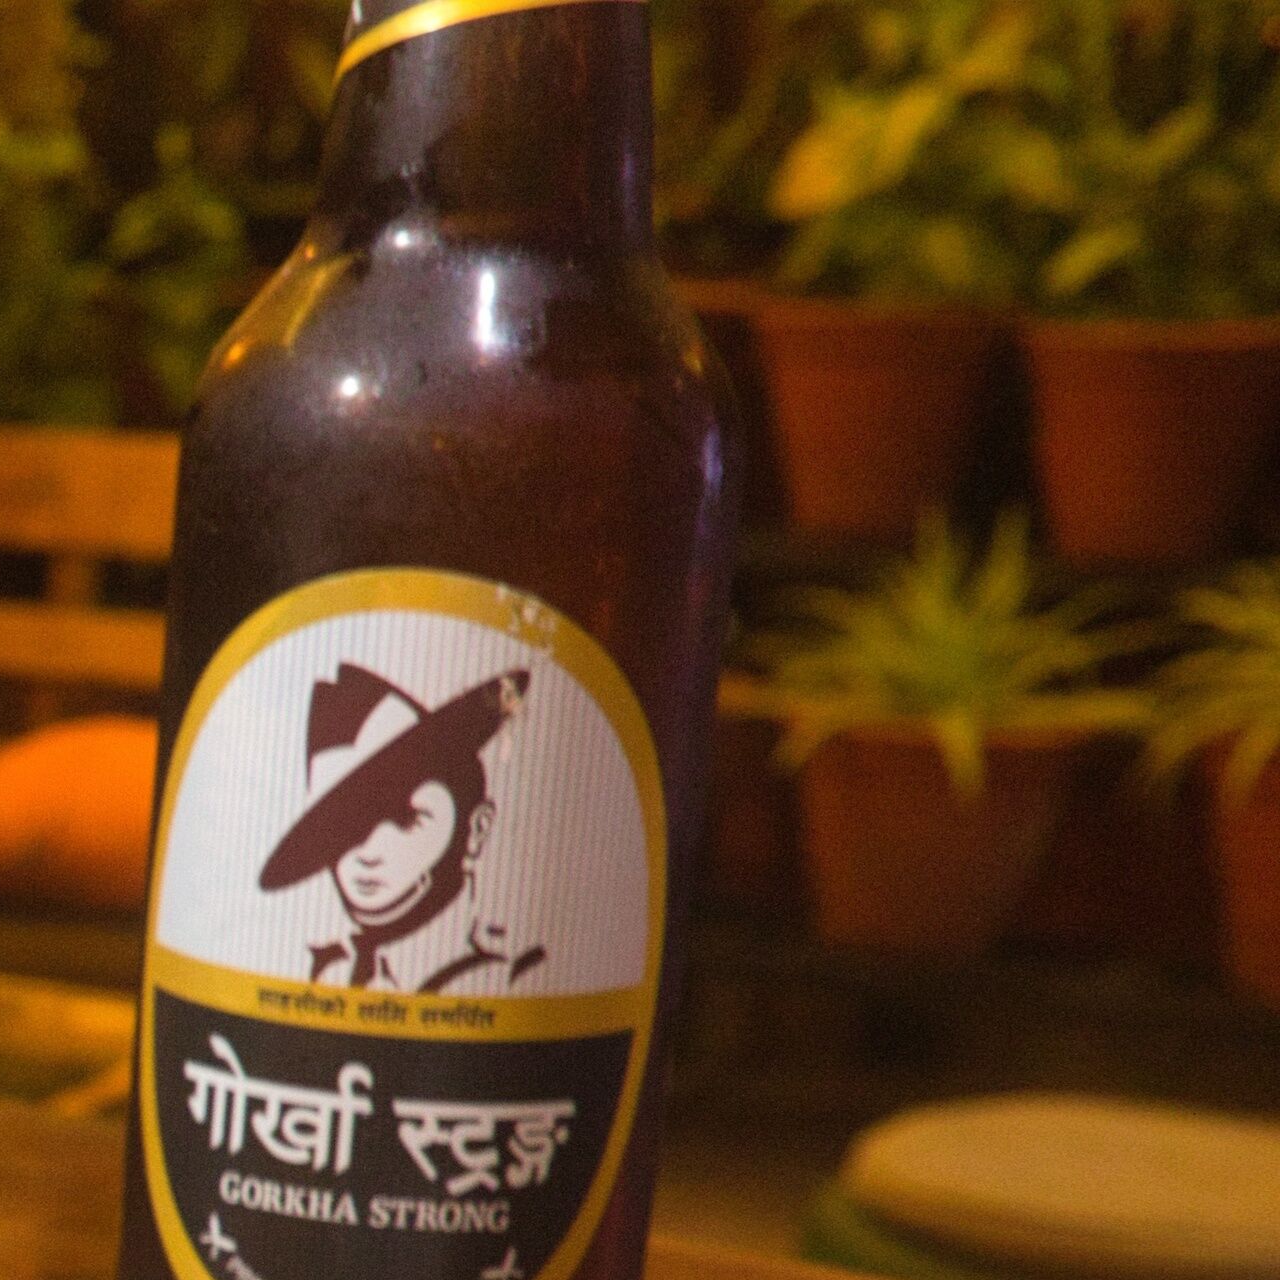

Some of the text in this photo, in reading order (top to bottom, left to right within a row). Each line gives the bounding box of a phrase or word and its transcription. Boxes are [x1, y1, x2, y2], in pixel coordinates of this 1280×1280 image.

[183, 1033, 373, 1173] गोर्खा
[220, 1170, 509, 1233] GORKHA STRONG
